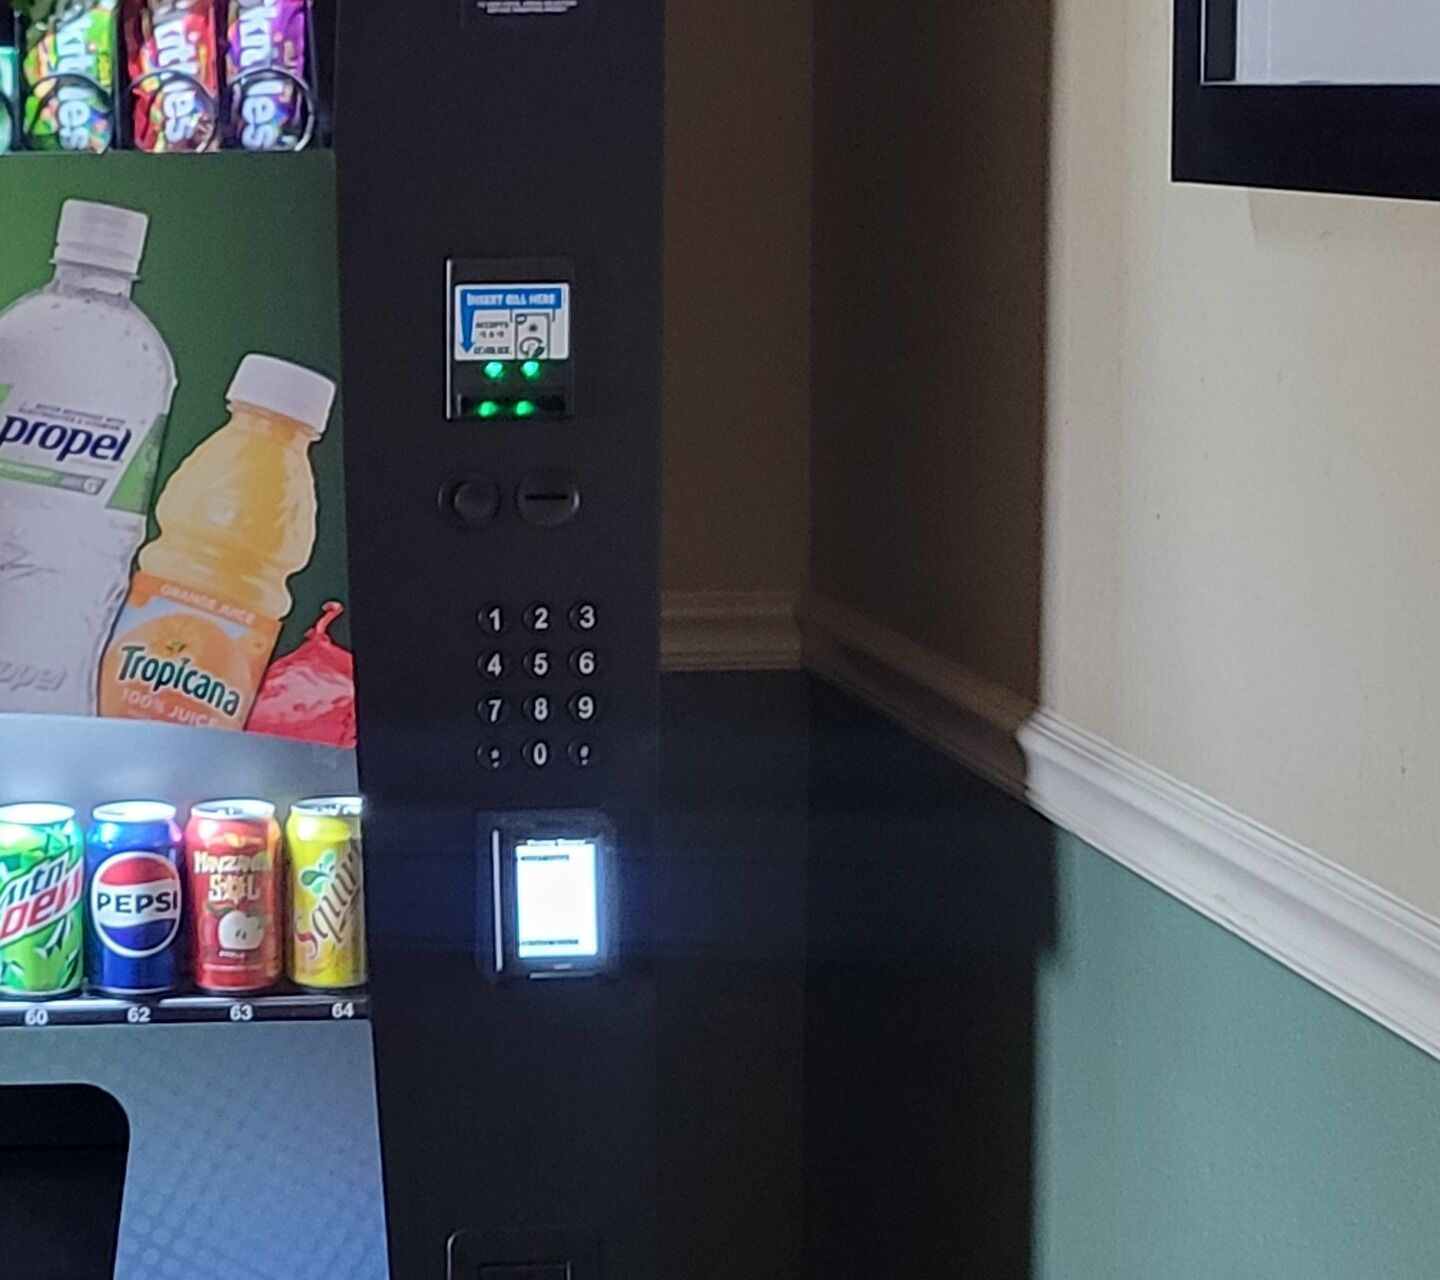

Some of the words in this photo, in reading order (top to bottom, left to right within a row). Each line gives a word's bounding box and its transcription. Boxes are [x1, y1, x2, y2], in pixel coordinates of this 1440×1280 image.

[161, 584, 216, 610] ORANGE
[220, 601, 255, 626] JUICE
[489, 608, 500, 631] 1
[534, 607, 548, 630] 2
[579, 605, 595, 629] 3
[487, 653, 502, 676] 4
[534, 652, 548, 675] 5
[578, 651, 595, 675] 6
[118, 645, 241, 718] Tropicana
[488, 699, 502, 722] 7
[534, 697, 548, 720] 8
[577, 696, 594, 719] 9
[533, 742, 547, 766] 0
[97, 889, 178, 914] PEPSI
[25, 1008, 48, 1026] 60
[127, 1006, 151, 1023] 62
[229, 1004, 253, 1021] 63
[332, 1001, 355, 1019] 64
